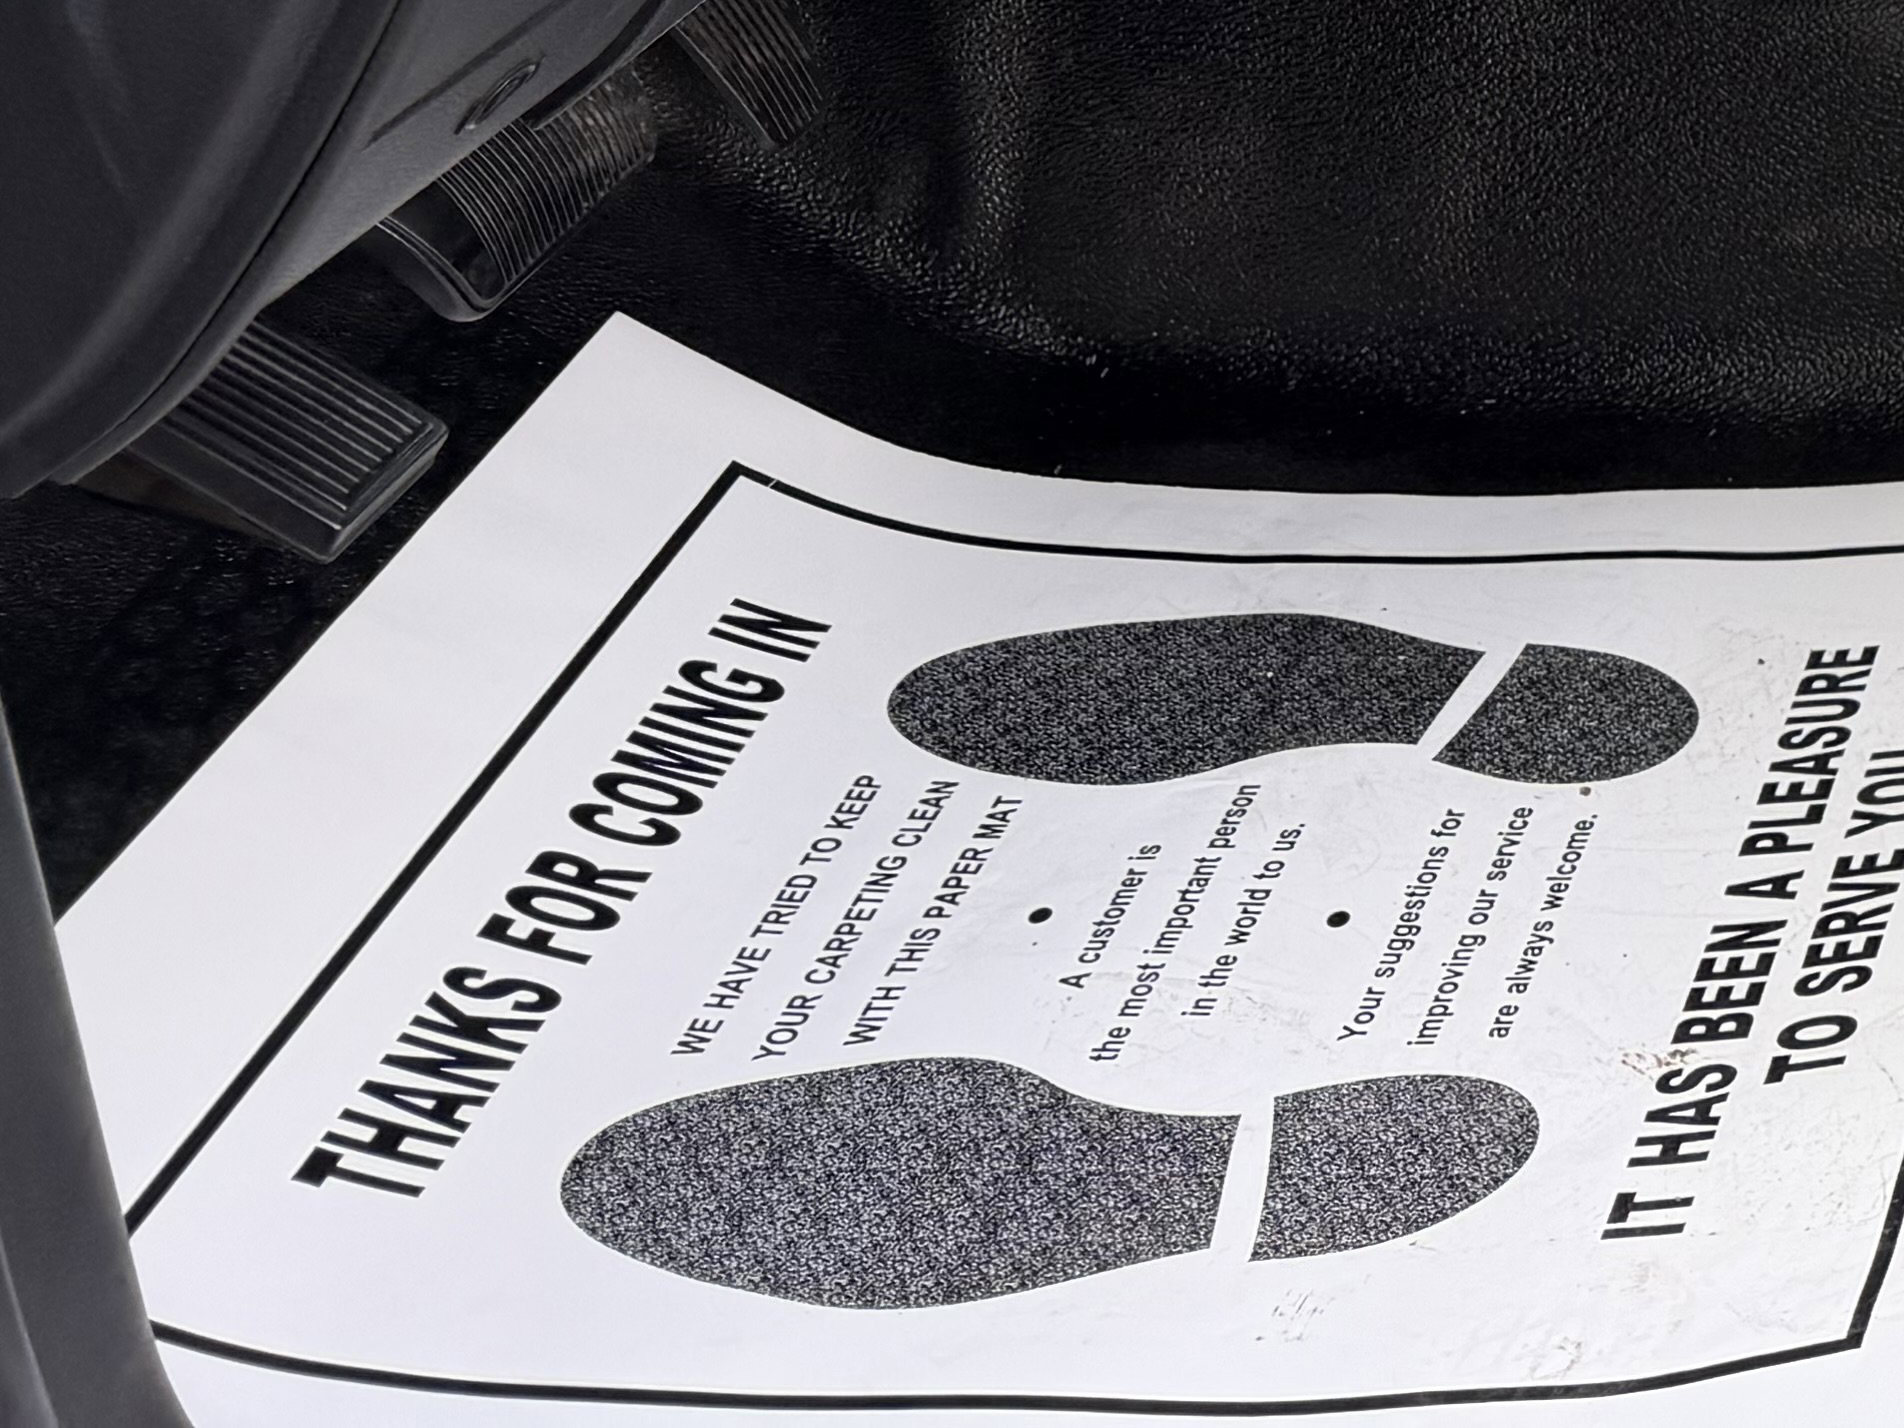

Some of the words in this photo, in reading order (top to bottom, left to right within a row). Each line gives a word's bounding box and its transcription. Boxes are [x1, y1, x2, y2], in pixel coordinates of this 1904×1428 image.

[1739, 645, 1880, 855] PLEASURE
[291, 967, 562, 1198] THANKS
[476, 850, 652, 965] FOR
[568, 659, 785, 847] COMING
[708, 598, 832, 662] IN
[1252, 860, 1285, 880] to
[1271, 823, 1306, 852] us.
[1724, 870, 1805, 900] A
[670, 1018, 724, 1055] WE
[703, 946, 772, 1010] HAVE
[749, 874, 818, 938] TRIED
[799, 837, 843, 866] TO
[824, 775, 881, 830] KEEP
[751, 995, 823, 1060] YOUR
[804, 856, 908, 985] CARPETING
[891, 781, 960, 847] CLEAN
[842, 986, 907, 1046] WITH
[884, 928, 941, 977] THIS
[922, 847, 994, 919] PAPER
[972, 795, 1023, 839] MAT
[1058, 972, 1092, 989] A
[1078, 868, 1148, 964] customer
[1127, 844, 1162, 861] is
[1089, 1026, 1132, 1061] the
[1117, 963, 1166, 1017] most
[1142, 856, 1222, 954] important
[1207, 784, 1261, 849] person
[1198, 954, 1238, 988] the
[1224, 888, 1272, 946] world
[1336, 986, 1386, 1041] Your
[1374, 846, 1449, 978] suggestions
[1430, 808, 1465, 838] for
[1406, 934, 1487, 1046] improving
[1467, 889, 1498, 926] our
[1486, 807, 1534, 881] service
[1488, 1004, 1520, 1038] are
[1505, 920, 1555, 994] always
[1540, 814, 1598, 912] welcome.
[1671, 919, 1788, 1044] BEEN
[1180, 998, 1218, 1016] in
[1763, 1014, 1858, 1085] TO
[1627, 1061, 1738, 1168] HAS
[1600, 1192, 1695, 1240] IT
